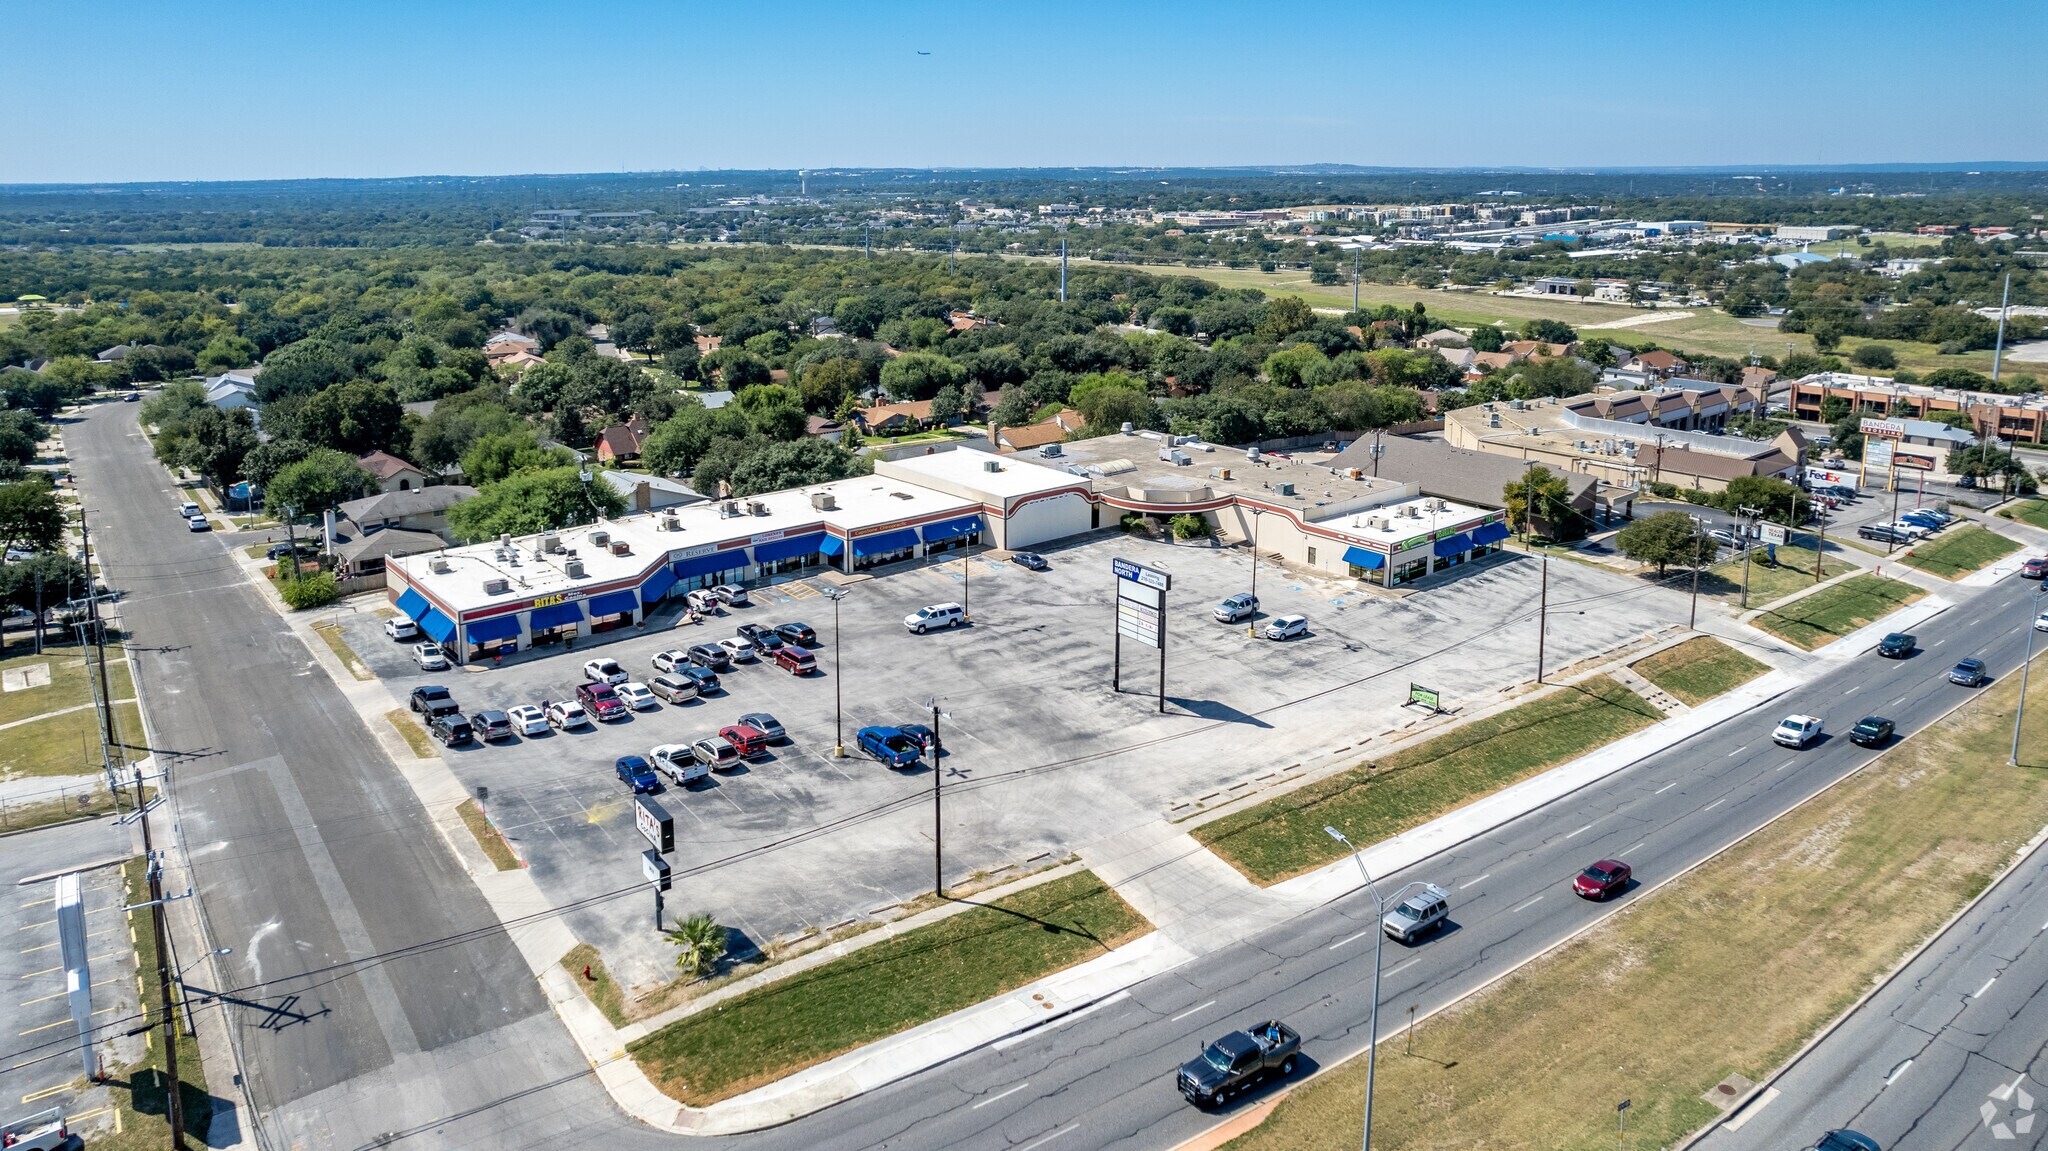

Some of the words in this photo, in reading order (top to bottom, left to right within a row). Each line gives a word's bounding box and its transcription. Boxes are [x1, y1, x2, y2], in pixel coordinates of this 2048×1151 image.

[1862, 420, 1901, 431] BANDERA
[1809, 469, 1840, 483] FedEx
[1768, 527, 1784, 535] HEALTH
[1768, 531, 1783, 539] TEXAS
[686, 546, 714, 557] RESERVE
[1114, 560, 1140, 574] BANDERA
[1114, 566, 1133, 579] NORTH
